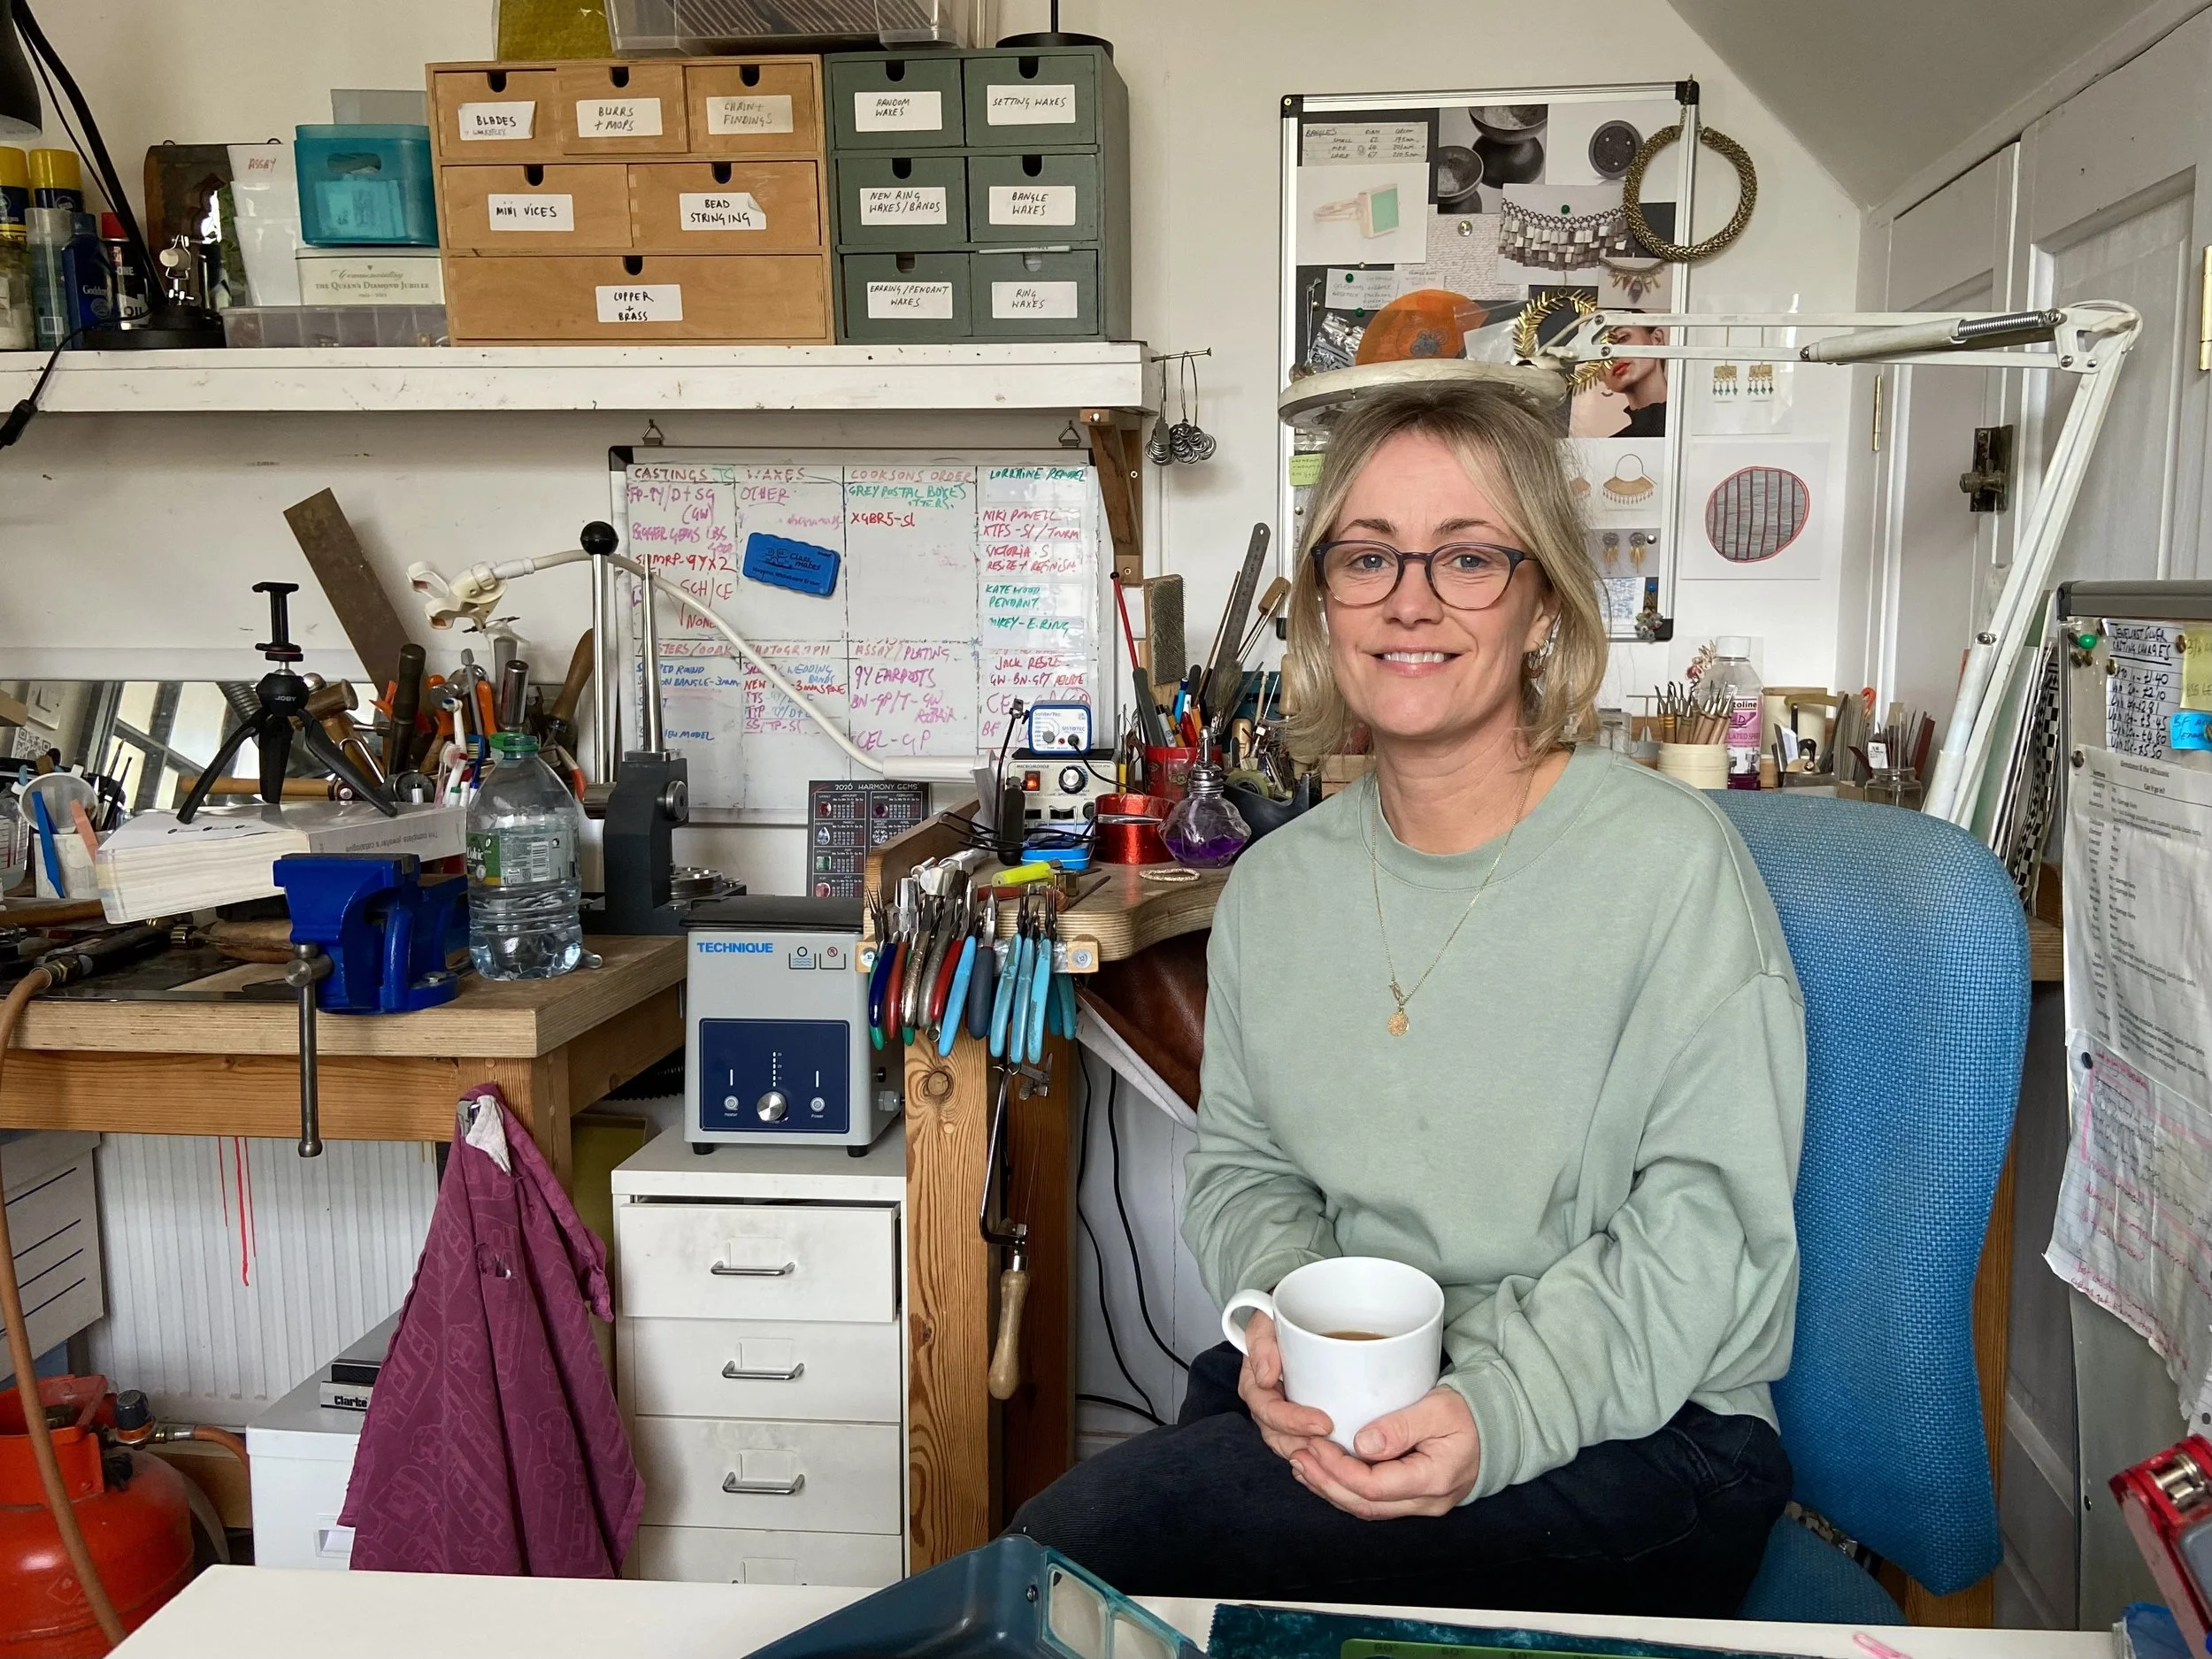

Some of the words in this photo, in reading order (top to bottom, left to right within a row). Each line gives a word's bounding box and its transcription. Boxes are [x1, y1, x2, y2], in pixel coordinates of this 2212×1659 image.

[875, 97, 910, 107] RANDOM
[992, 96, 1030, 110] SETTING
[1034, 96, 1067, 108] WAXES
[598, 105, 634, 118] BURRS
[875, 107, 904, 117] WAXES
[476, 115, 517, 127] BLADES
[605, 119, 634, 133] MOPS
[723, 112, 773, 127] FINDINGS
[248, 157, 277, 173] ASSAY
[869, 191, 891, 202] NEW
[895, 189, 920, 203] RING
[1011, 191, 1049, 204] BANGLE
[495, 202, 518, 218] MINI
[524, 203, 557, 218] VICES
[704, 198, 730, 211] BEAD
[1012, 204, 1046, 217] WAXES
[363, 281, 400, 290] DIAMOND
[401, 281, 430, 291] JUBILEE
[613, 290, 655, 303] COPPER
[1016, 288, 1037, 299] RING
[890, 296, 921, 308] WAXES
[1011, 298, 1045, 310] WAXES
[618, 311, 649, 322] BRASS
[635, 467, 708, 482] CASTINGS
[850, 469, 923, 482] COOKSONS
[930, 470, 972, 482] ORDER
[740, 485, 790, 503] OTHER
[849, 484, 880, 499] GREY
[881, 484, 924, 499] POSTAL
[926, 482, 966, 500] BOXES
[1010, 509, 1063, 522] POWELL
[789, 552, 810, 563] Class
[795, 561, 821, 571] mates
[986, 583, 1013, 595] KATE
[1013, 586, 1041, 595] WOOD
[995, 656, 1023, 671] JACK
[743, 679, 767, 690] NEW
[679, 729, 715, 741] MODEL
[834, 782, 854, 791] 2026
[696, 941, 773, 954] TECHNIQUE
[334, 1395, 368, 1408] Clarke
